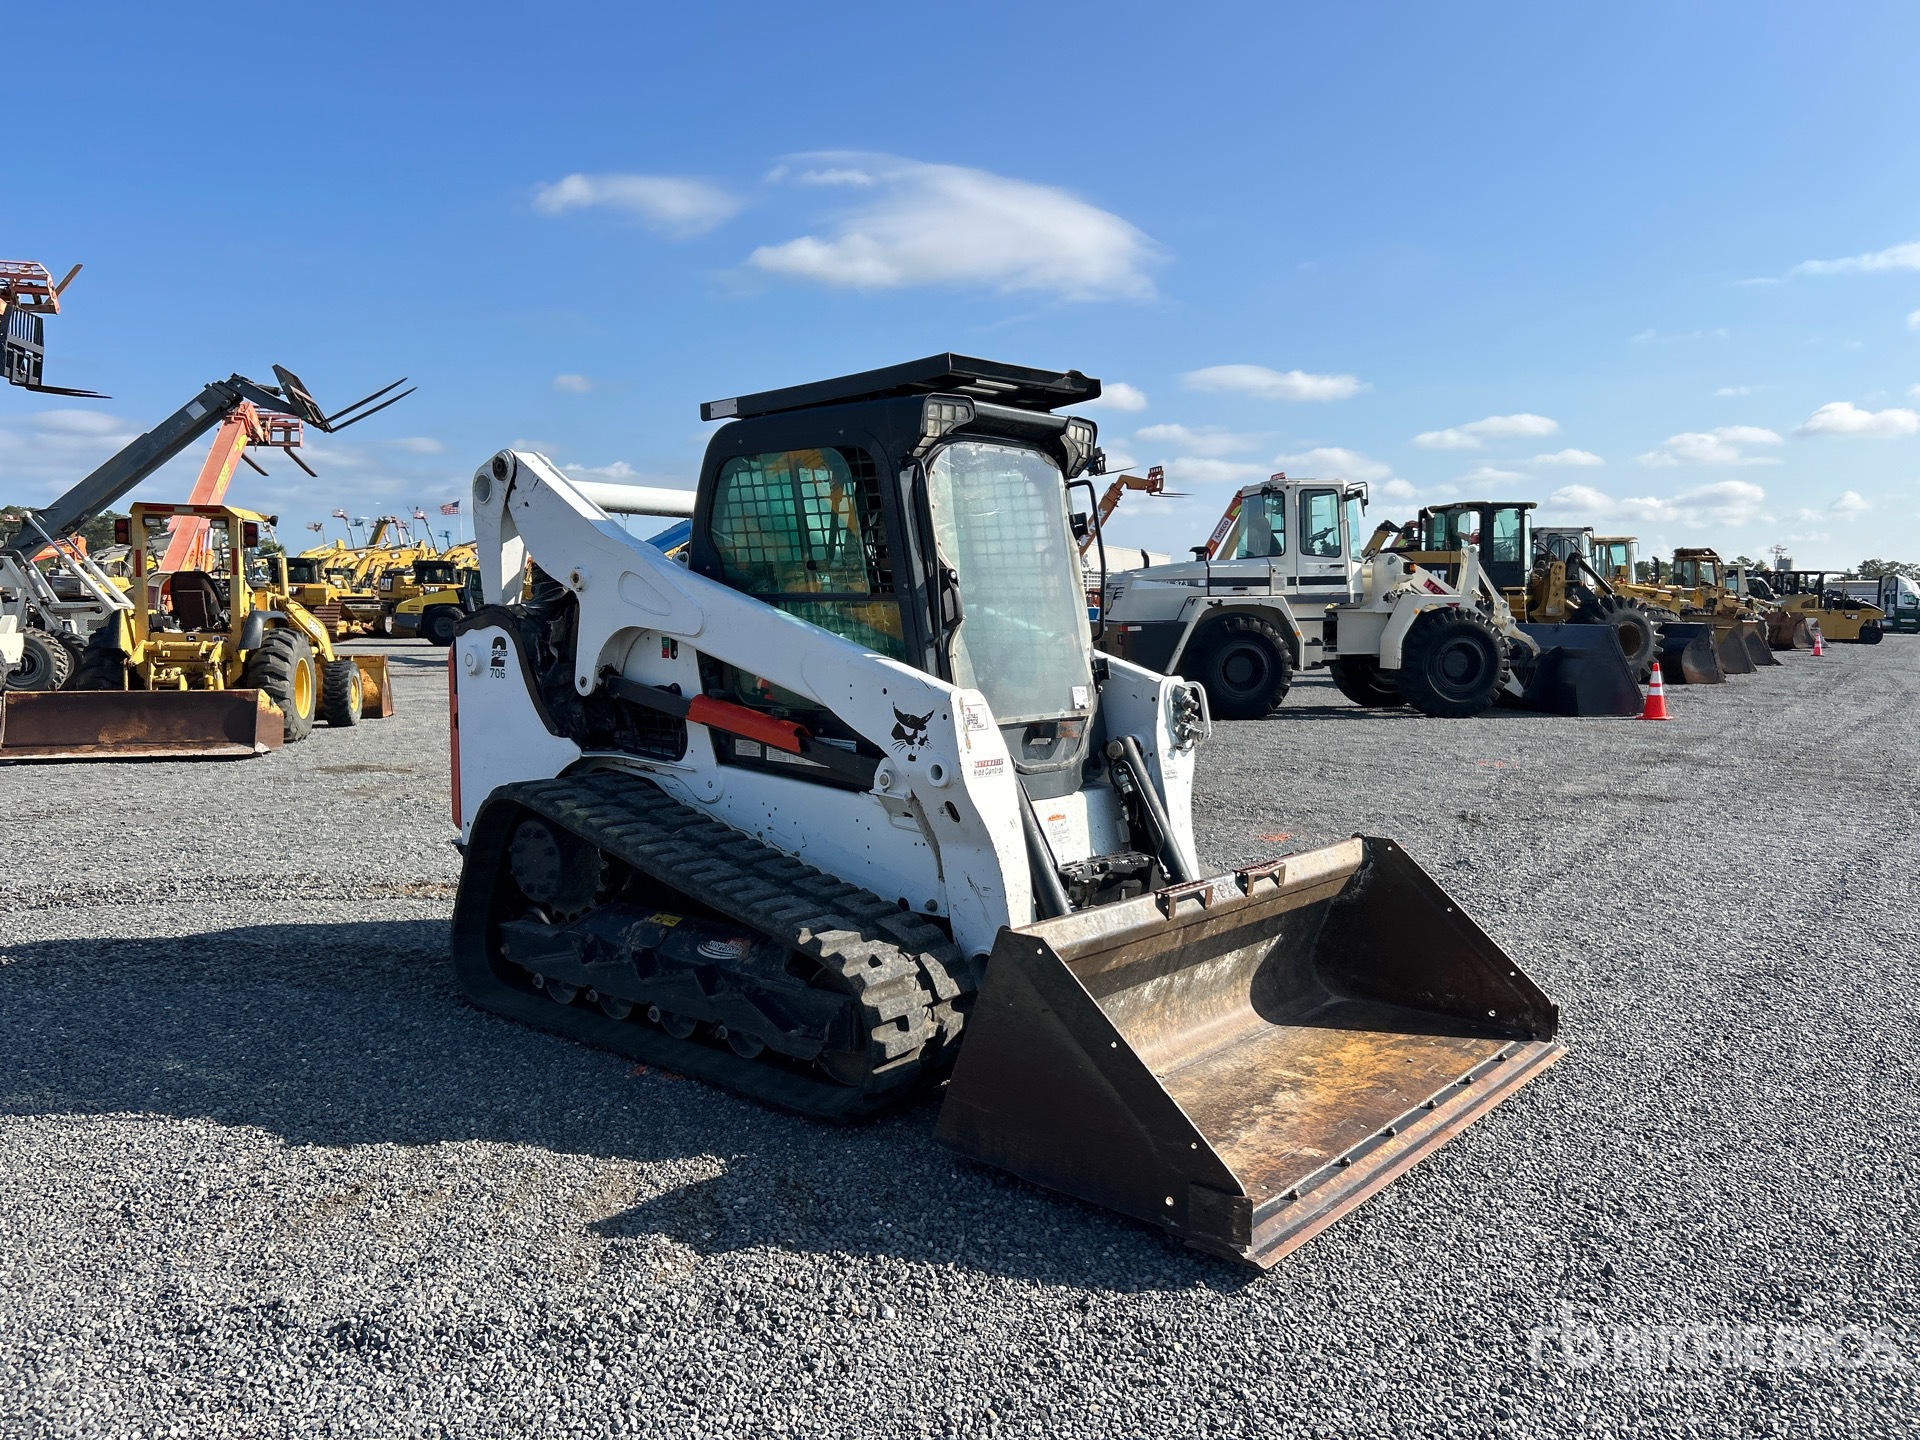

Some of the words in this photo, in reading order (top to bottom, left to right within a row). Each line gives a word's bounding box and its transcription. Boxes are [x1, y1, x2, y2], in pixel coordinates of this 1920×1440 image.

[1214, 519, 1230, 541] AMECO
[380, 577, 392, 591] CAT
[425, 586, 440, 595] CAT
[491, 636, 507, 667] 2
[490, 668, 506, 679] 706
